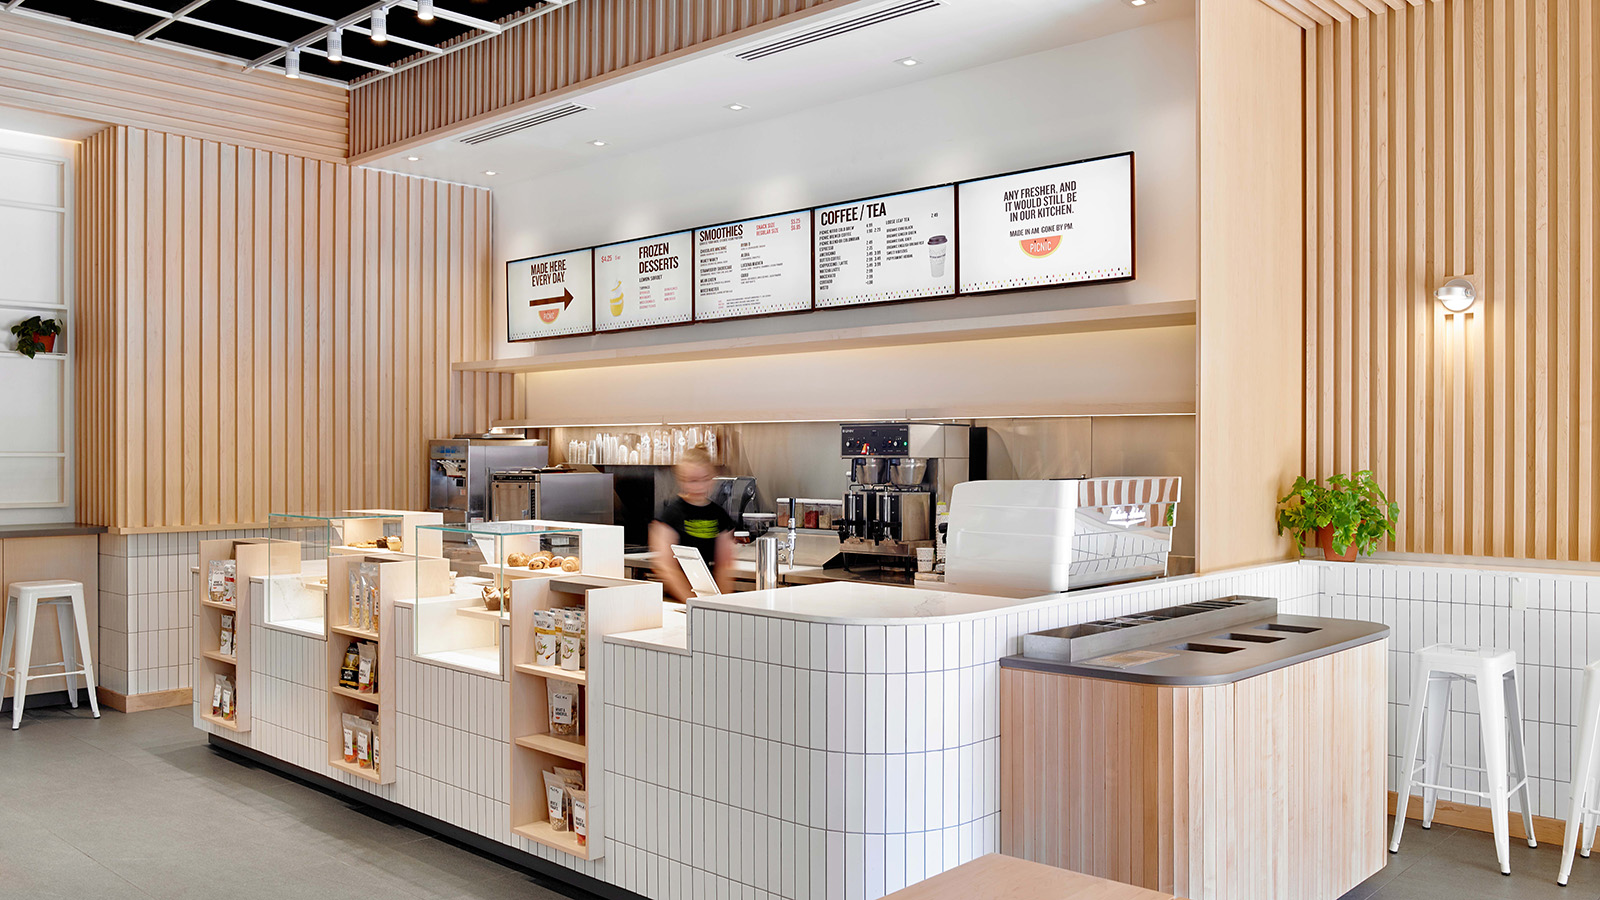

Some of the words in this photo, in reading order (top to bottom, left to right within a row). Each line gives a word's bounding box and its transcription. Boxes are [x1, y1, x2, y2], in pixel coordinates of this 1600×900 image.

[1004, 190, 1019, 201] ANY
[1060, 181, 1076, 192] AND
[1005, 202, 1012, 212] IT
[1014, 198, 1041, 210] WOULD
[1044, 195, 1064, 206] STILL
[1067, 192, 1077, 202] BE
[821, 207, 858, 226] COFFEE
[860, 204, 864, 221] /
[867, 202, 886, 218] TEA
[1010, 212, 1018, 222] IN
[1020, 209, 1035, 220] OUR
[1038, 204, 1074, 218] KITCHEN.
[700, 224, 743, 242] SMOOTHIES
[1041, 225, 1055, 233] GONE
[639, 242, 669, 258] FROZEN
[1030, 241, 1051, 252] PICNIC
[531, 262, 548, 275] MADE
[550, 259, 566, 272] HERE
[639, 256, 678, 274] DESSERTS
[532, 274, 551, 287] EVERY
[553, 272, 565, 284] DAY
